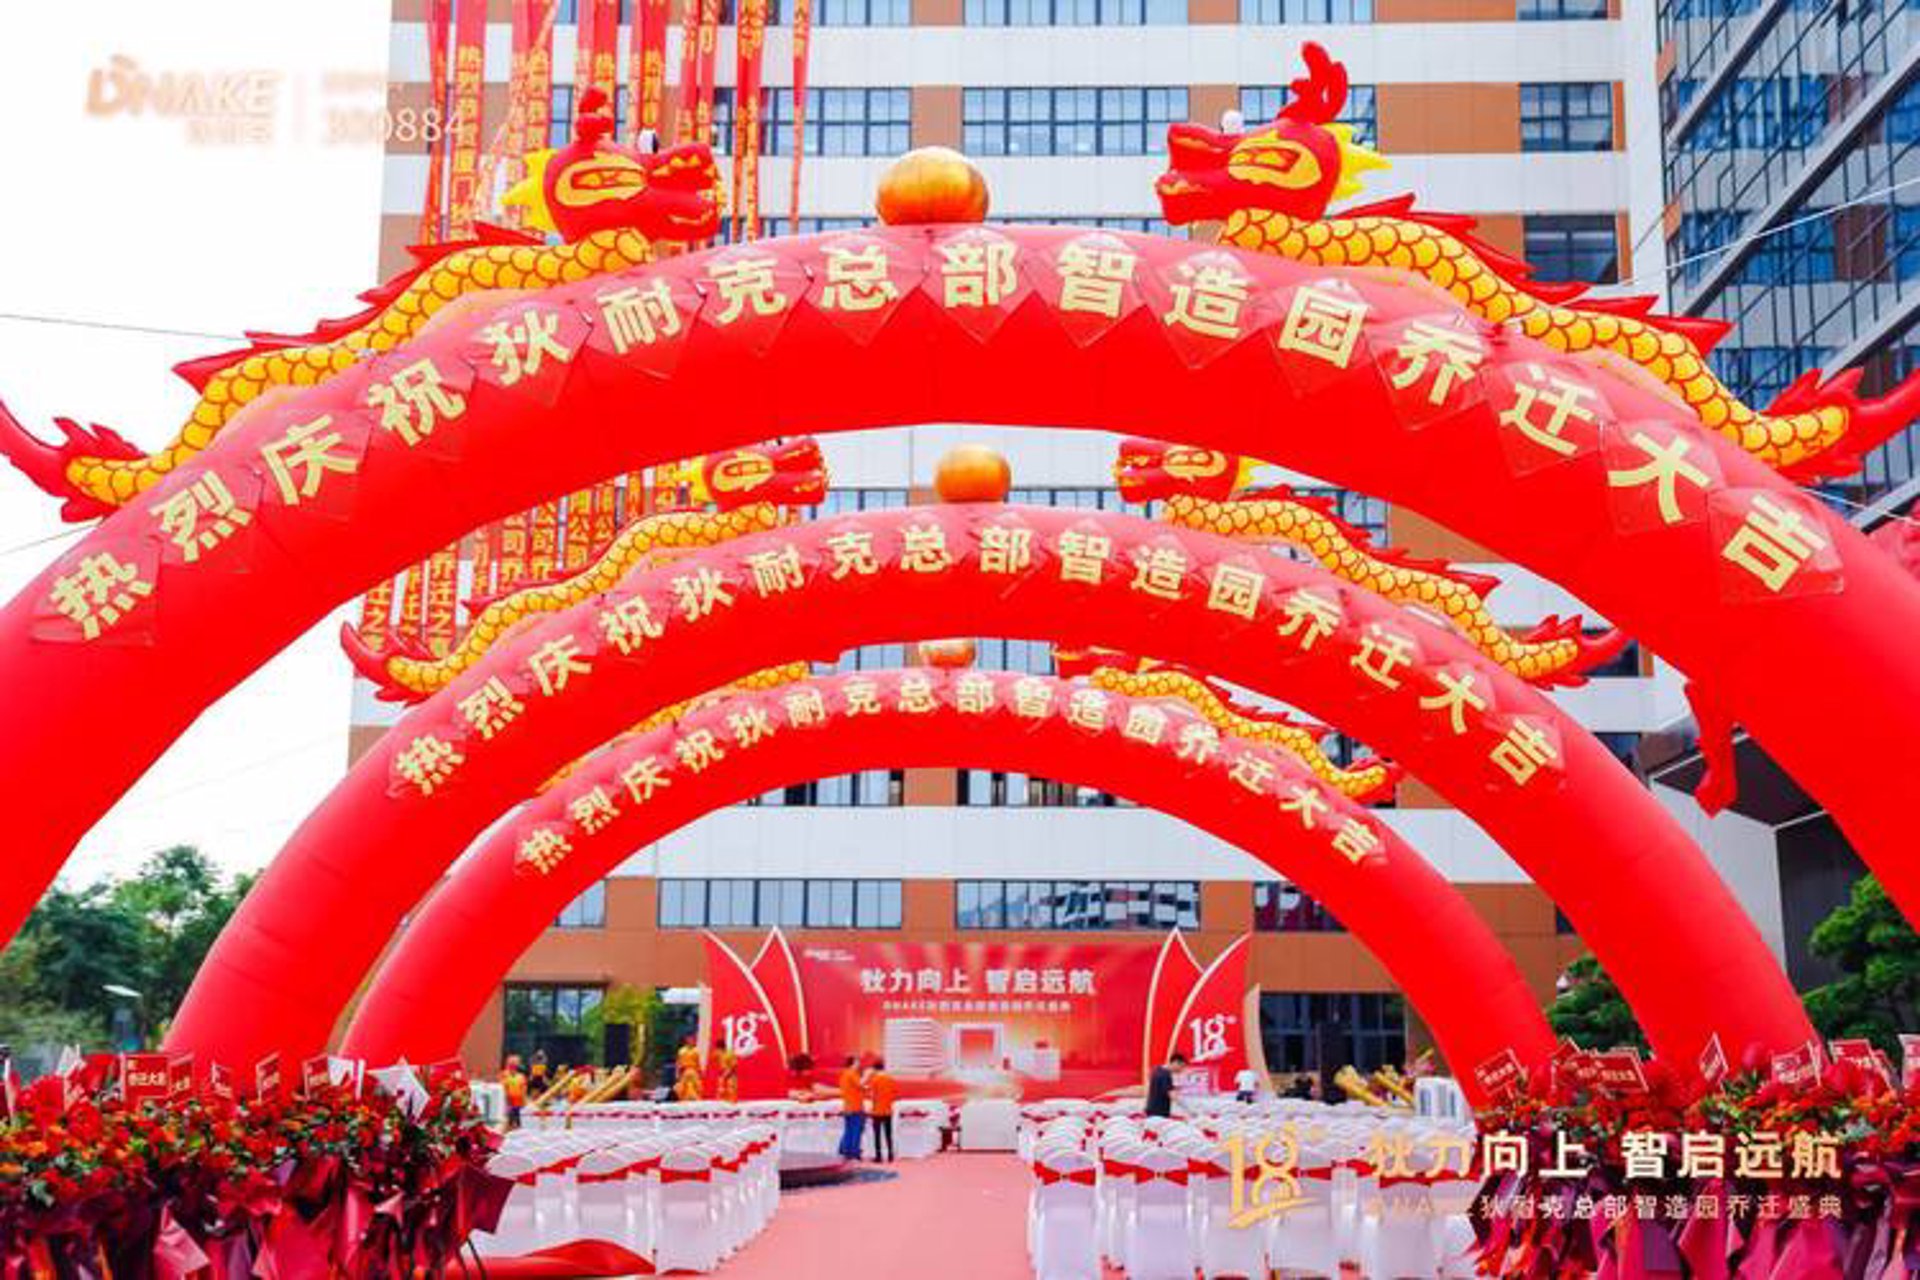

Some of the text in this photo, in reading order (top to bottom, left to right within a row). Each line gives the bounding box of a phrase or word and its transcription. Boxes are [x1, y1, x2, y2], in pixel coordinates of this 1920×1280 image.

[47, 238, 1828, 639] 热烈庆祝狄耐克总部智造园乔迁大吉
[396, 524, 1560, 796] 热烈庆祝狄耐克总部智造园乔迁大吉
[519, 676, 1380, 875] 热烈庆祝狄耐克总部智造园乔迁大吉
